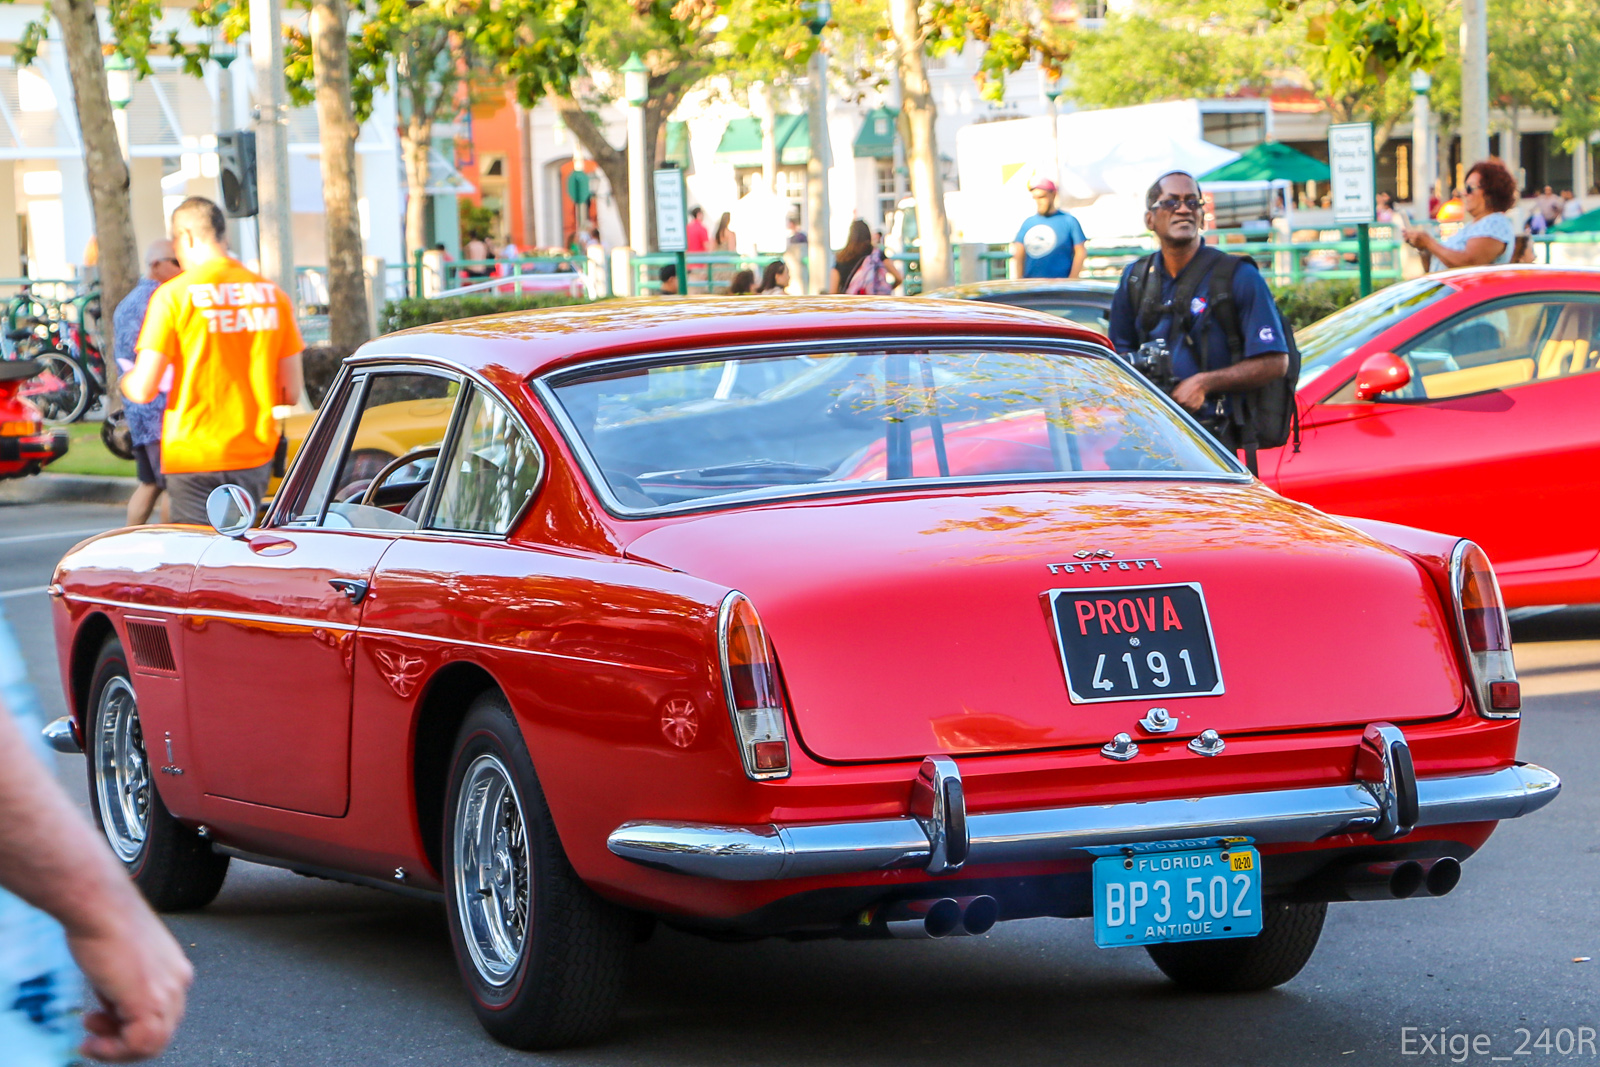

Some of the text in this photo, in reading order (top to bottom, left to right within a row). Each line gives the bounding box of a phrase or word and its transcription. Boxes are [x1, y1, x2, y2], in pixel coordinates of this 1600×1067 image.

[188, 283, 276, 307] EVENT
[202, 307, 278, 333] TEAM
[1048, 558, 1163, 574] Ferrari
[1074, 595, 1183, 635] PROVA
[1092, 649, 1197, 691] 4191
[1138, 855, 1214, 872] FLORIDA
[1234, 856, 1252, 870] 02-20
[1106, 873, 1252, 927] BP3 502
[1144, 921, 1213, 938] ANTIQUE
